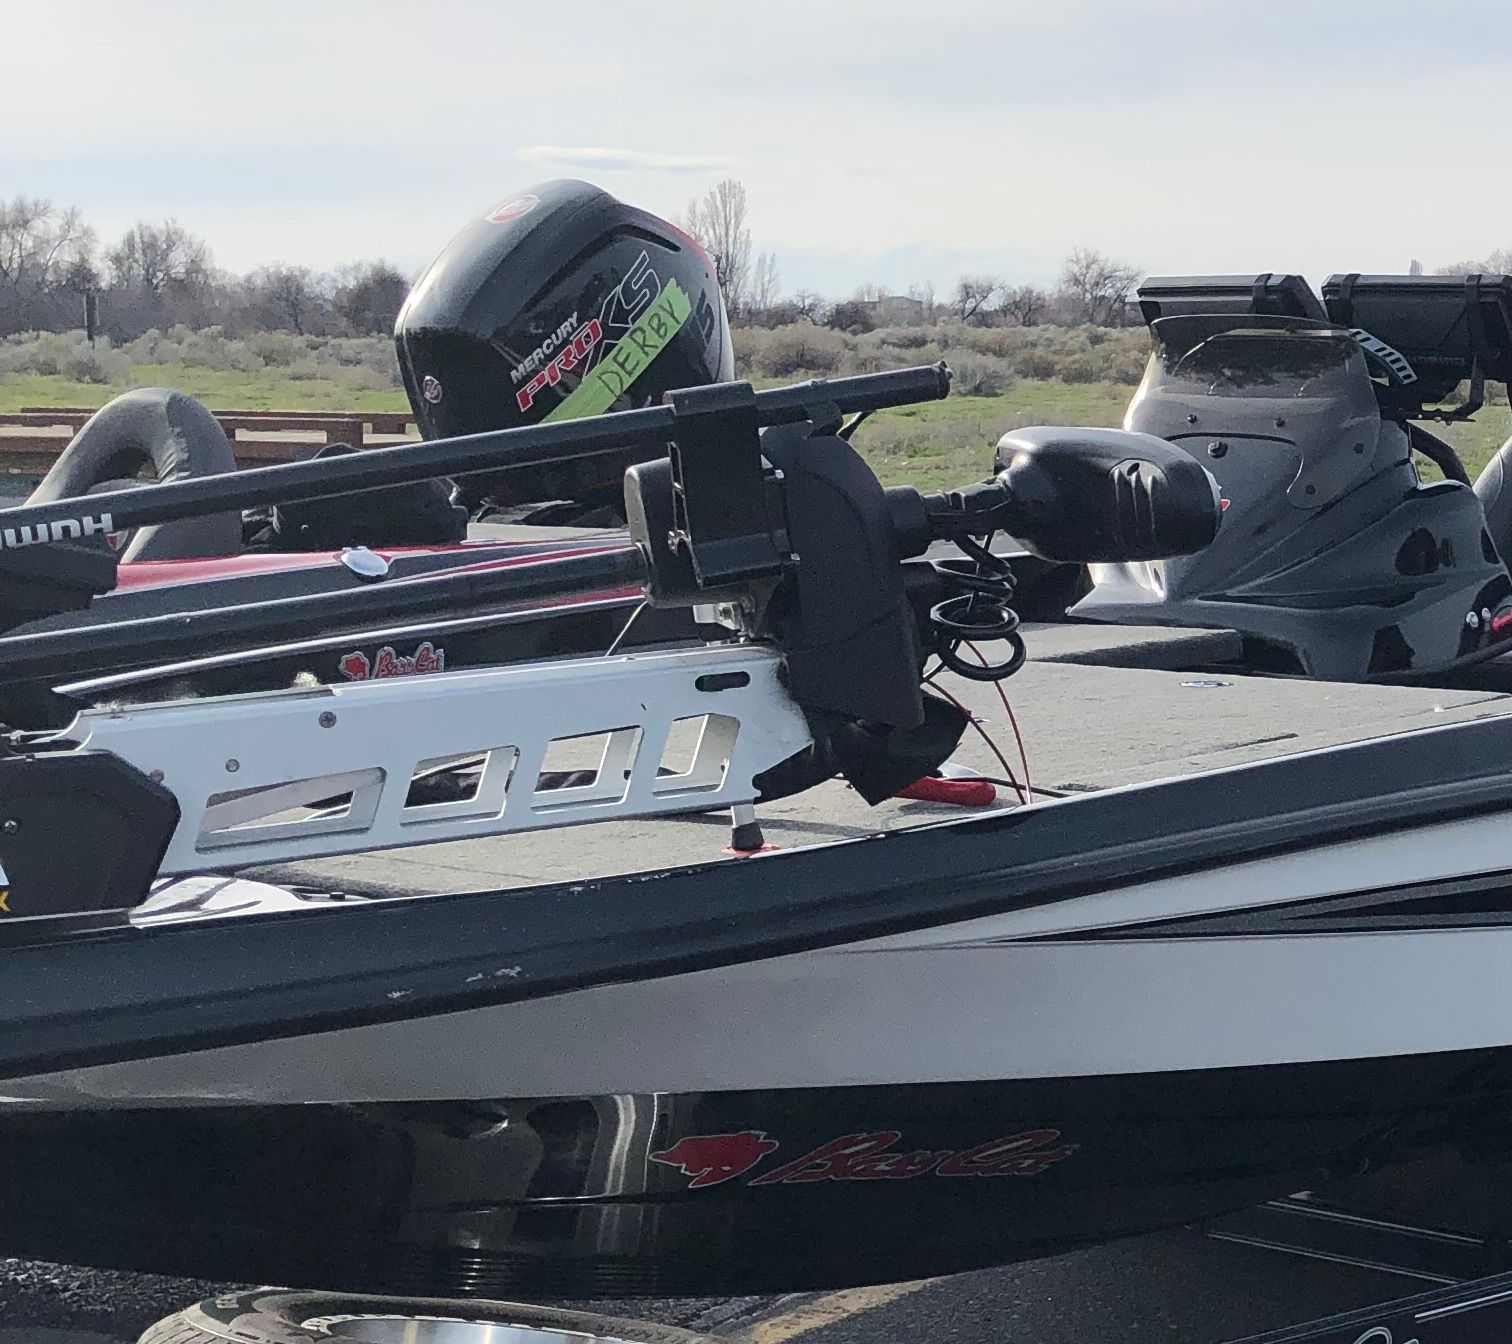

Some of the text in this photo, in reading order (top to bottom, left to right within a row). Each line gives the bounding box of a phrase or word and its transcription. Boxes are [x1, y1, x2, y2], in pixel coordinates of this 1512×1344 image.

[510, 311, 578, 385] MERCURY
[516, 319, 602, 413] PRO
[597, 299, 682, 400] DERBY
[936, 1129, 1080, 1177] Cat
